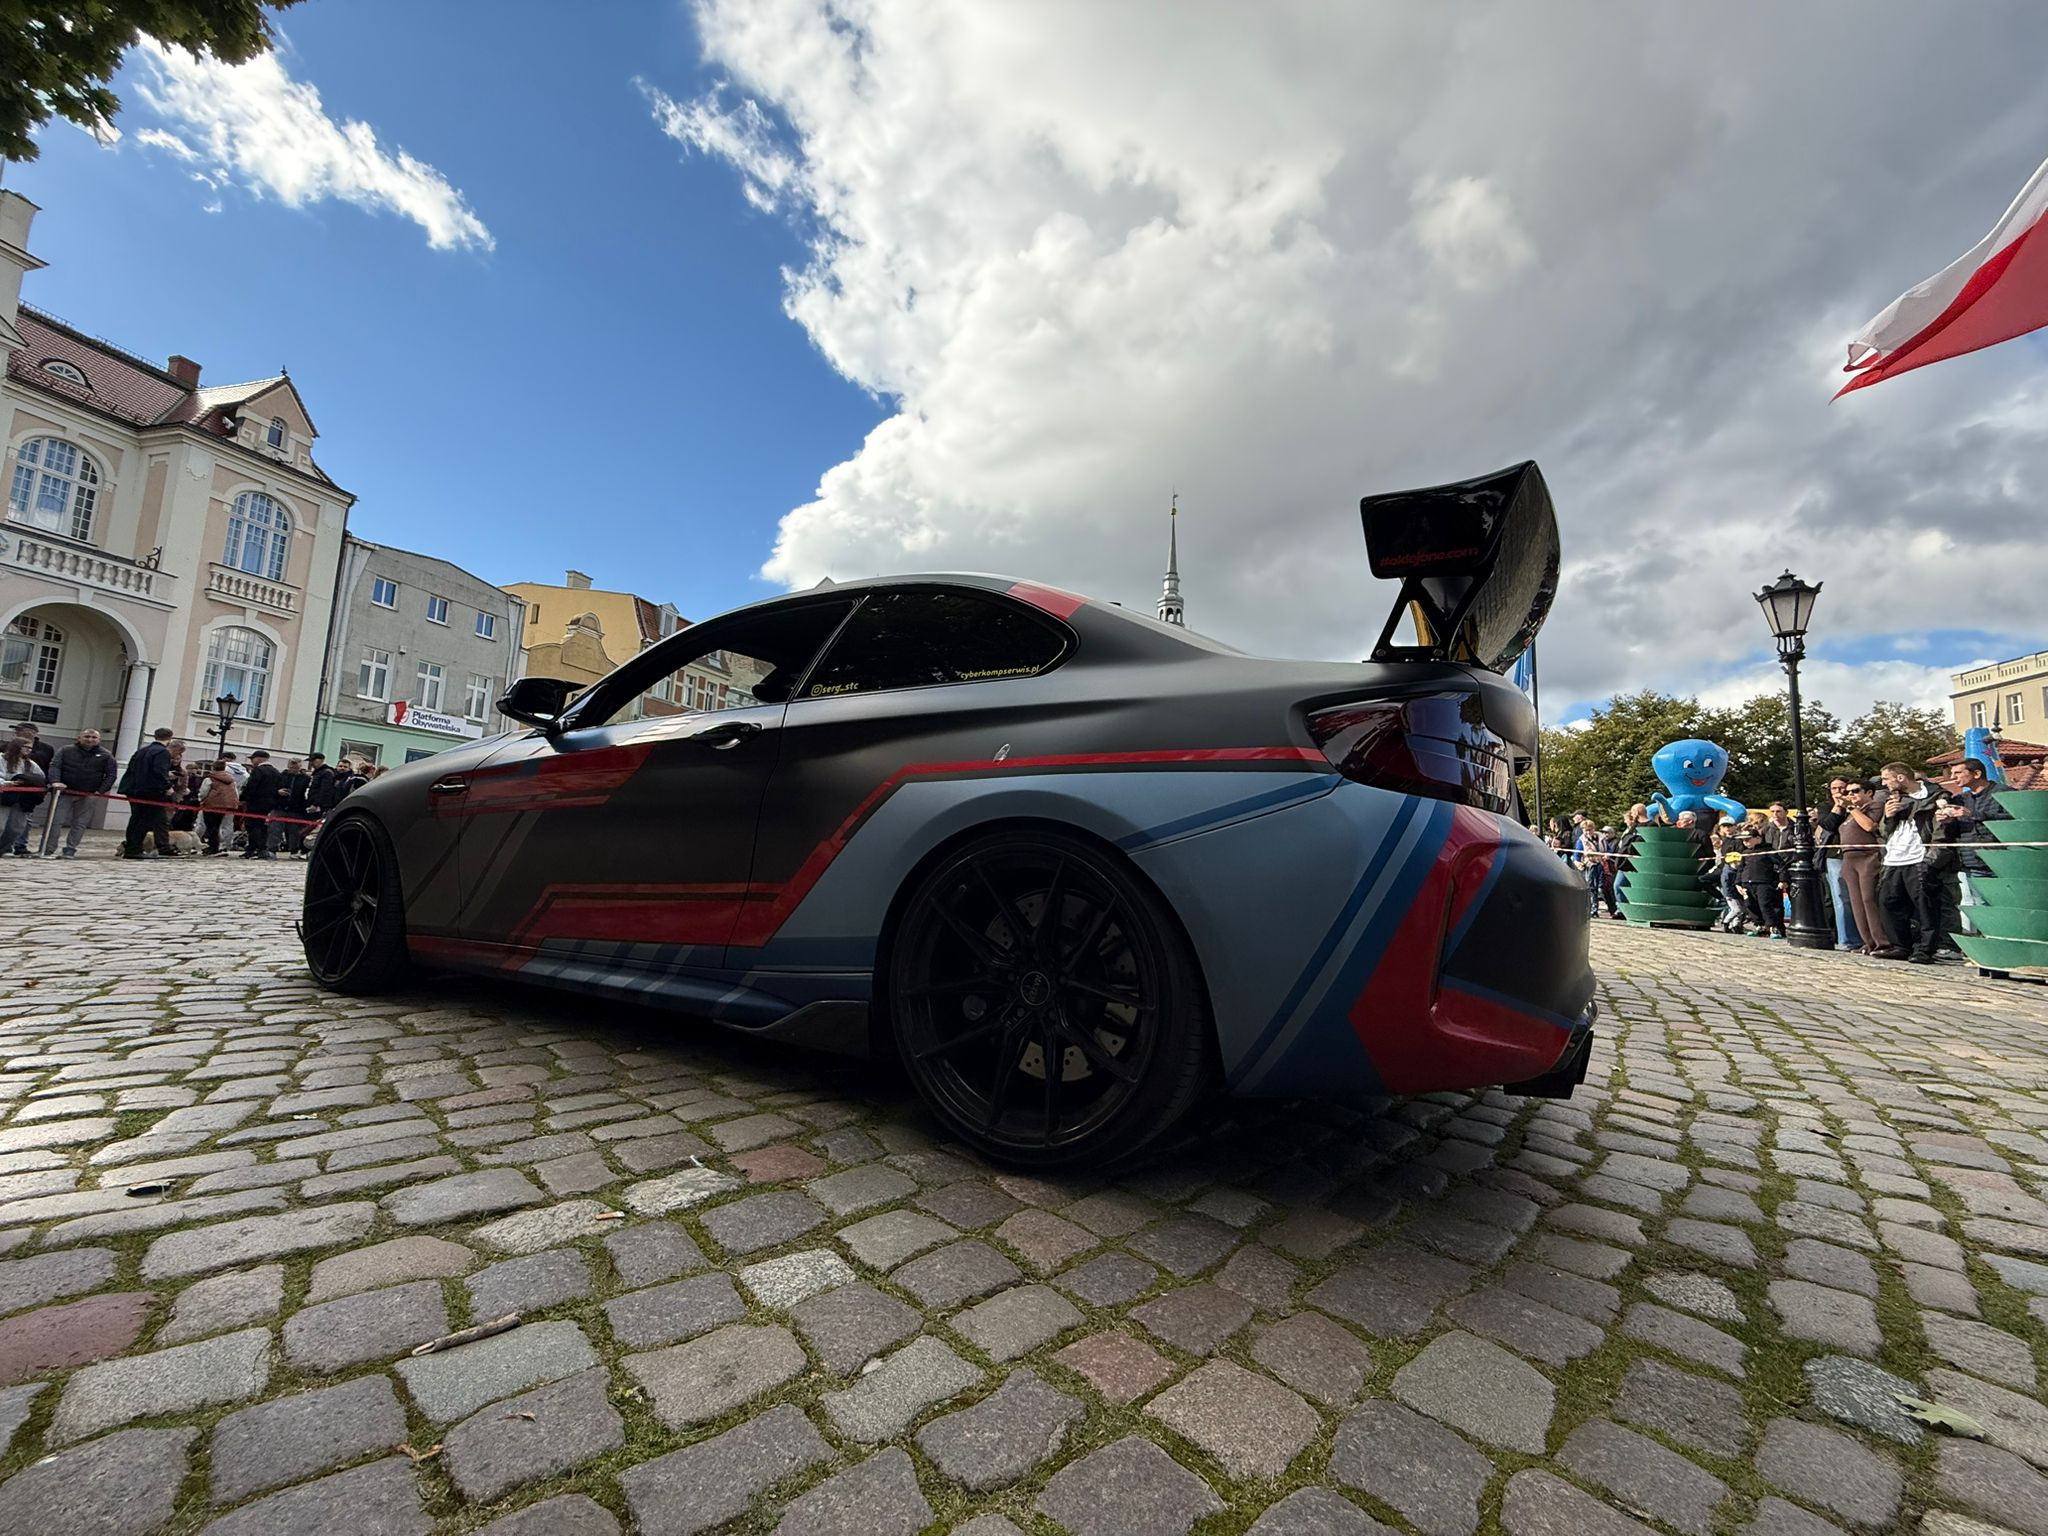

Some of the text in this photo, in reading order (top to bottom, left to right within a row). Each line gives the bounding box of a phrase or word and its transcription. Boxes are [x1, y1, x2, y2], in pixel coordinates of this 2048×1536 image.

[960, 665, 1040, 680] cyberkompserwis.pl
[412, 711, 450, 724] Platforma
[412, 718, 461, 732] Obywatelska
